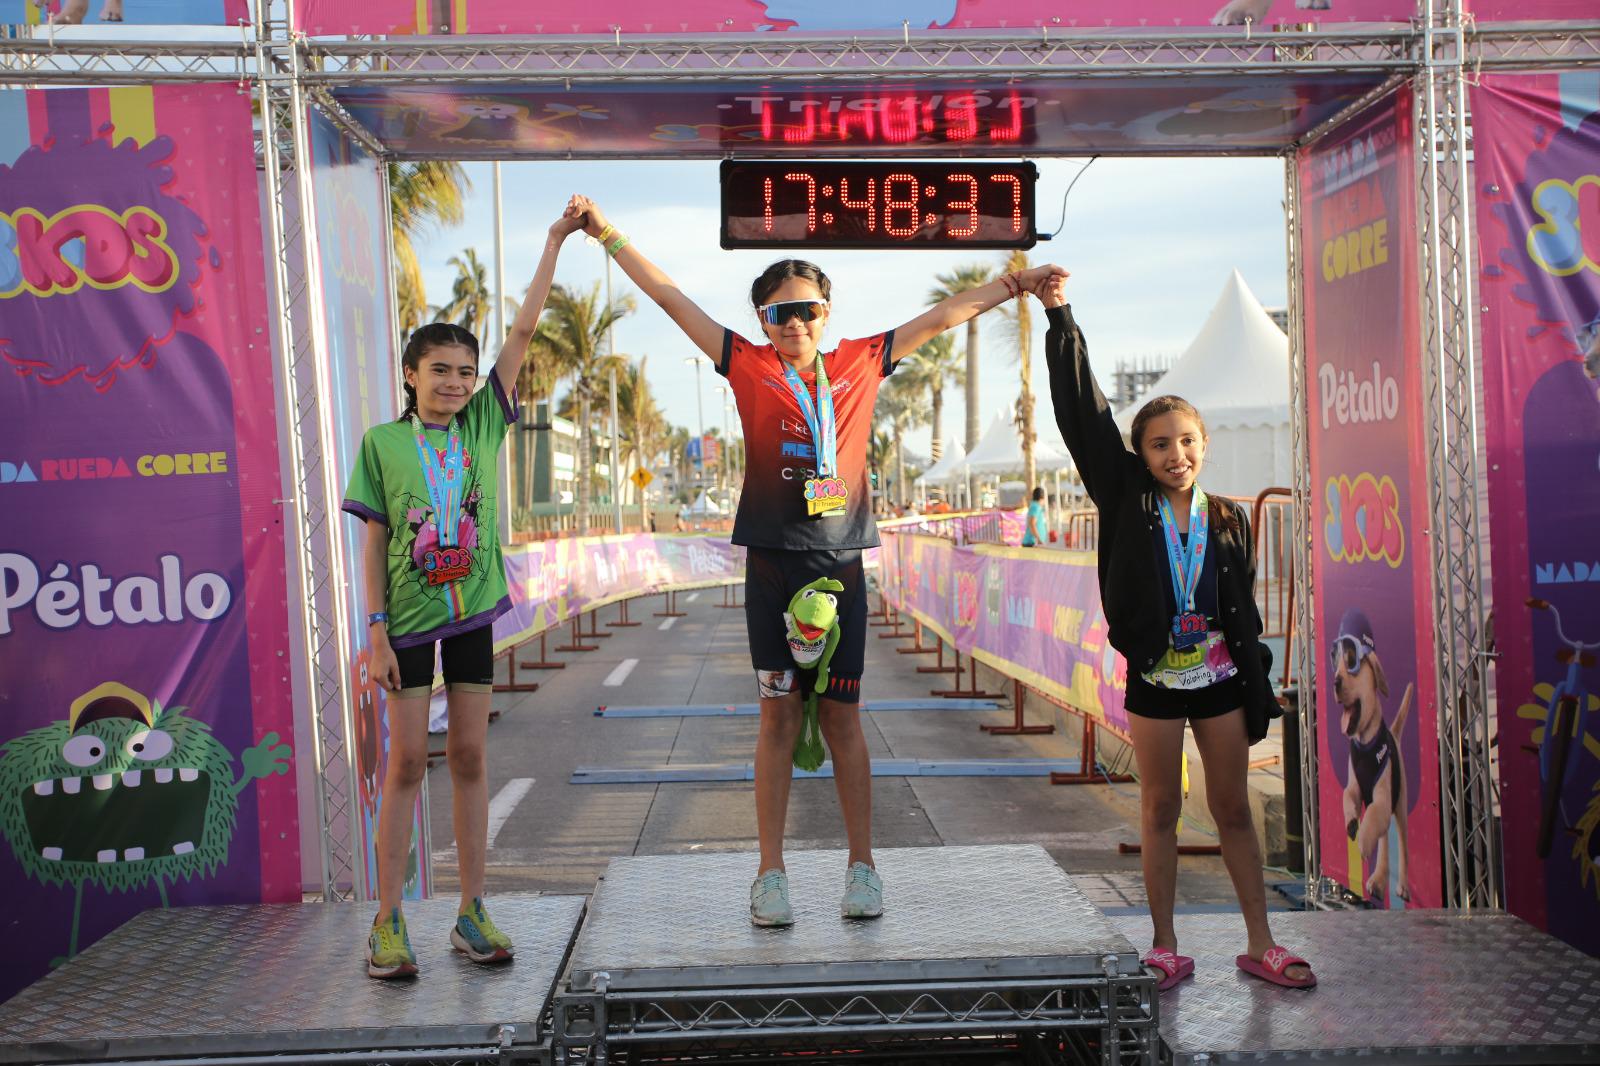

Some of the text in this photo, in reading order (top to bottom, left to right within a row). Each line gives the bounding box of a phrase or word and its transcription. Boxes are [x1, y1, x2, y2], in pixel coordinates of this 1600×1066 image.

[734, 89, 1038, 114] Triatlón
[764, 173, 1021, 236] 17:48:37
[1322, 175, 1386, 240] RUEDA
[1322, 218, 1388, 283] CORRE
[1318, 361, 1399, 430] Pétalo
[41, 455, 133, 480] RUEDA
[137, 451, 228, 477] CORRE
[0, 553, 231, 635] Pétalo
